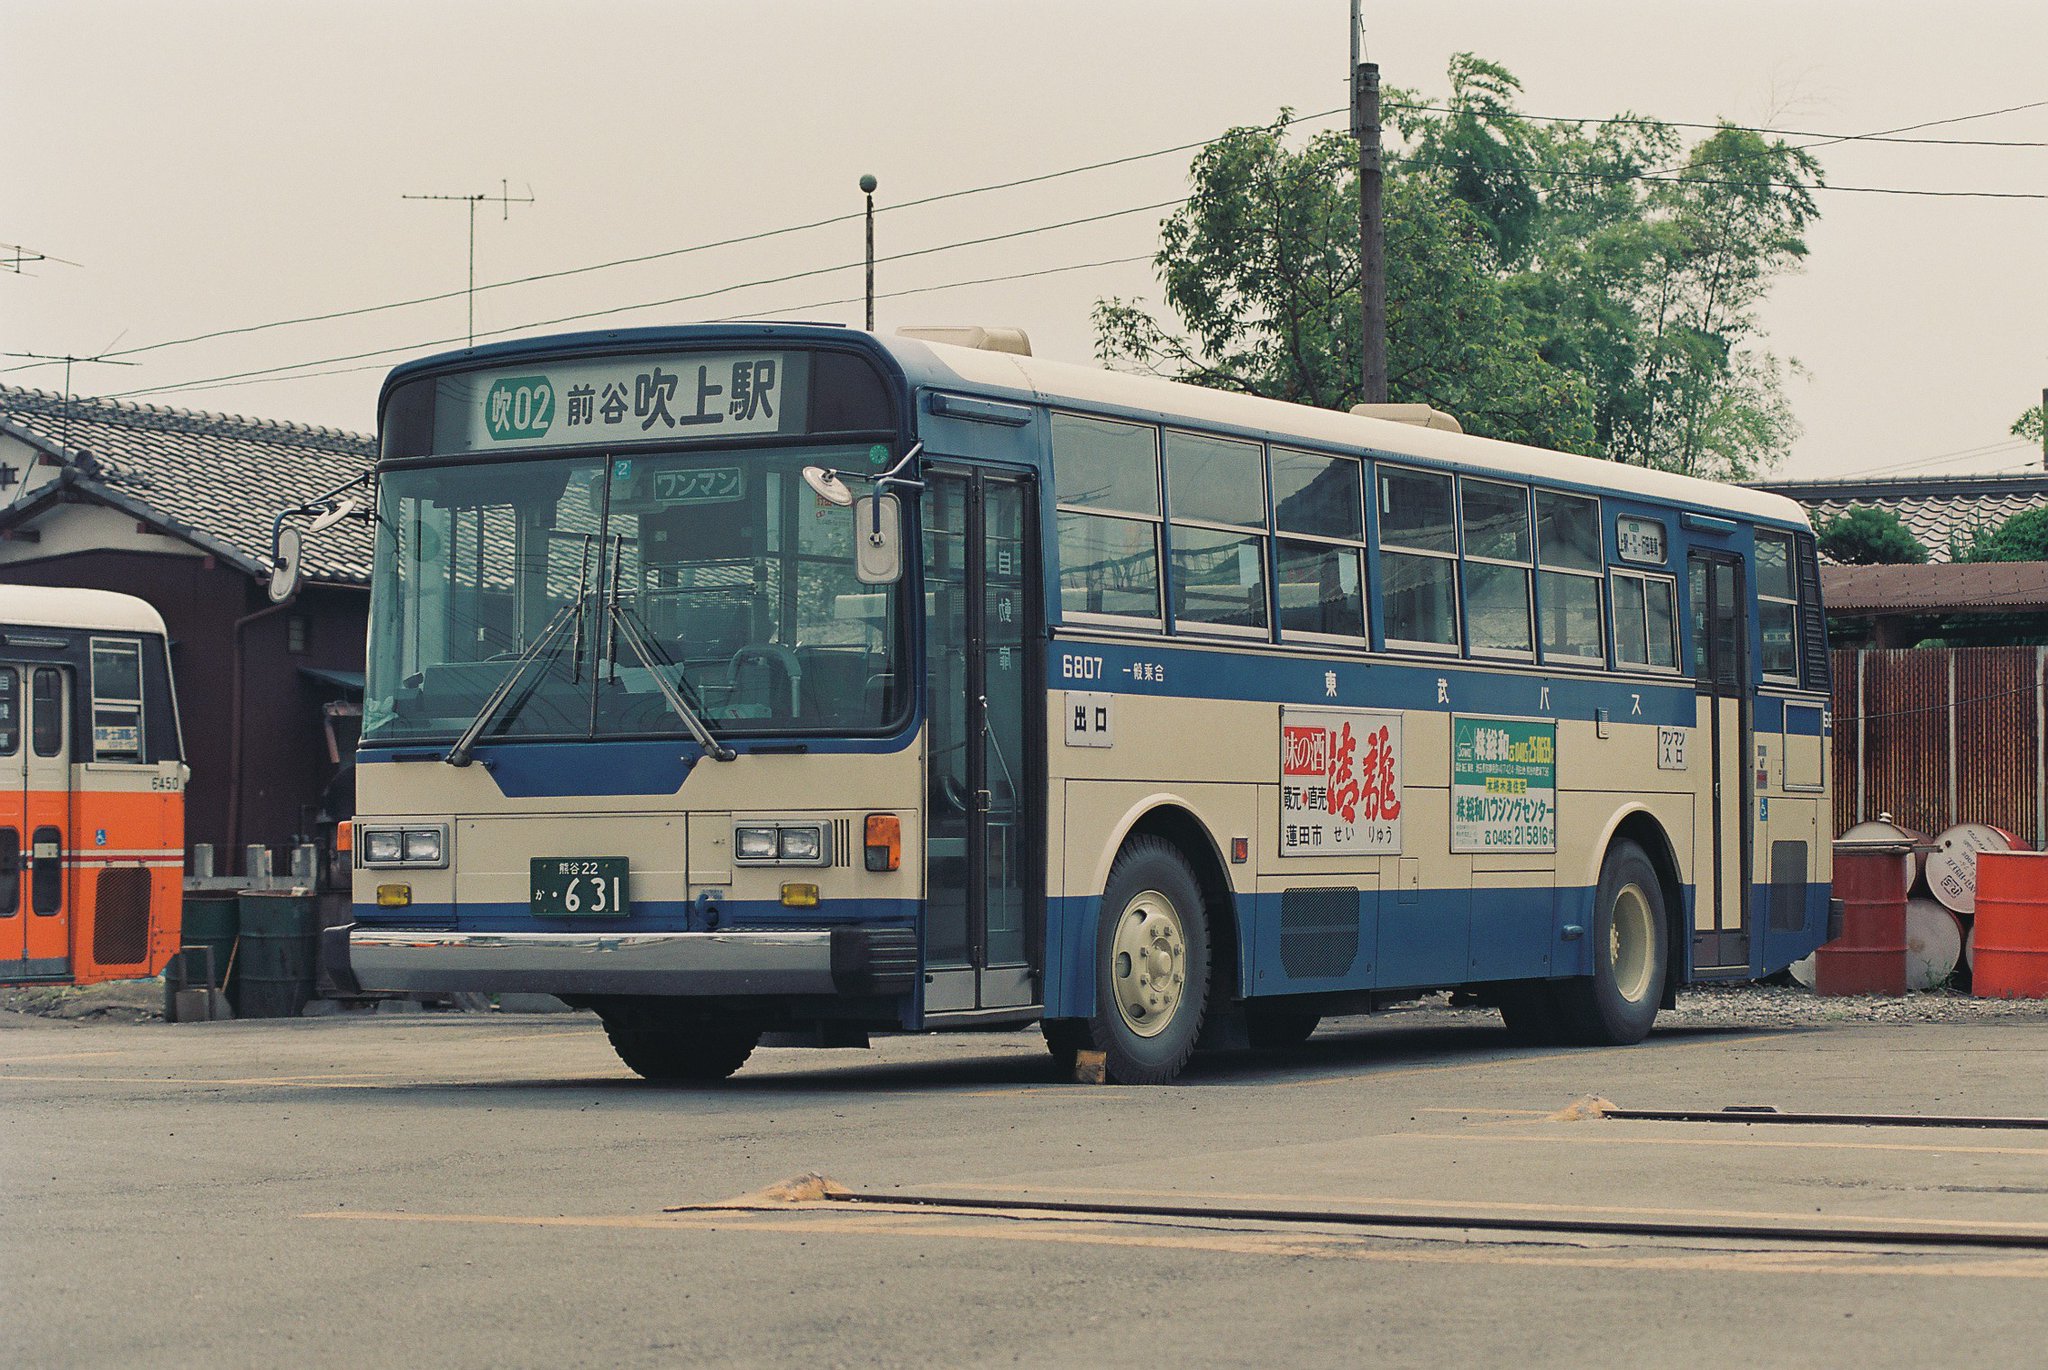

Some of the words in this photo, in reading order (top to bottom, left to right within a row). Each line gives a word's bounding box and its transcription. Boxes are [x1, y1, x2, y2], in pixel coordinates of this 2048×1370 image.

[492, 384, 549, 433] 吹02
[657, 471, 738, 497] ワンマン
[1063, 654, 1103, 680] 6807
[1122, 662, 1164, 682] 一般乗合
[1074, 705, 1107, 732] 出口
[1284, 730, 1326, 772] 味の酒
[1661, 731, 1686, 747] ワンマン
[1664, 748, 1683, 764] 入口
[152, 776, 179, 791] 6450
[1286, 824, 1323, 847] 蓮田市
